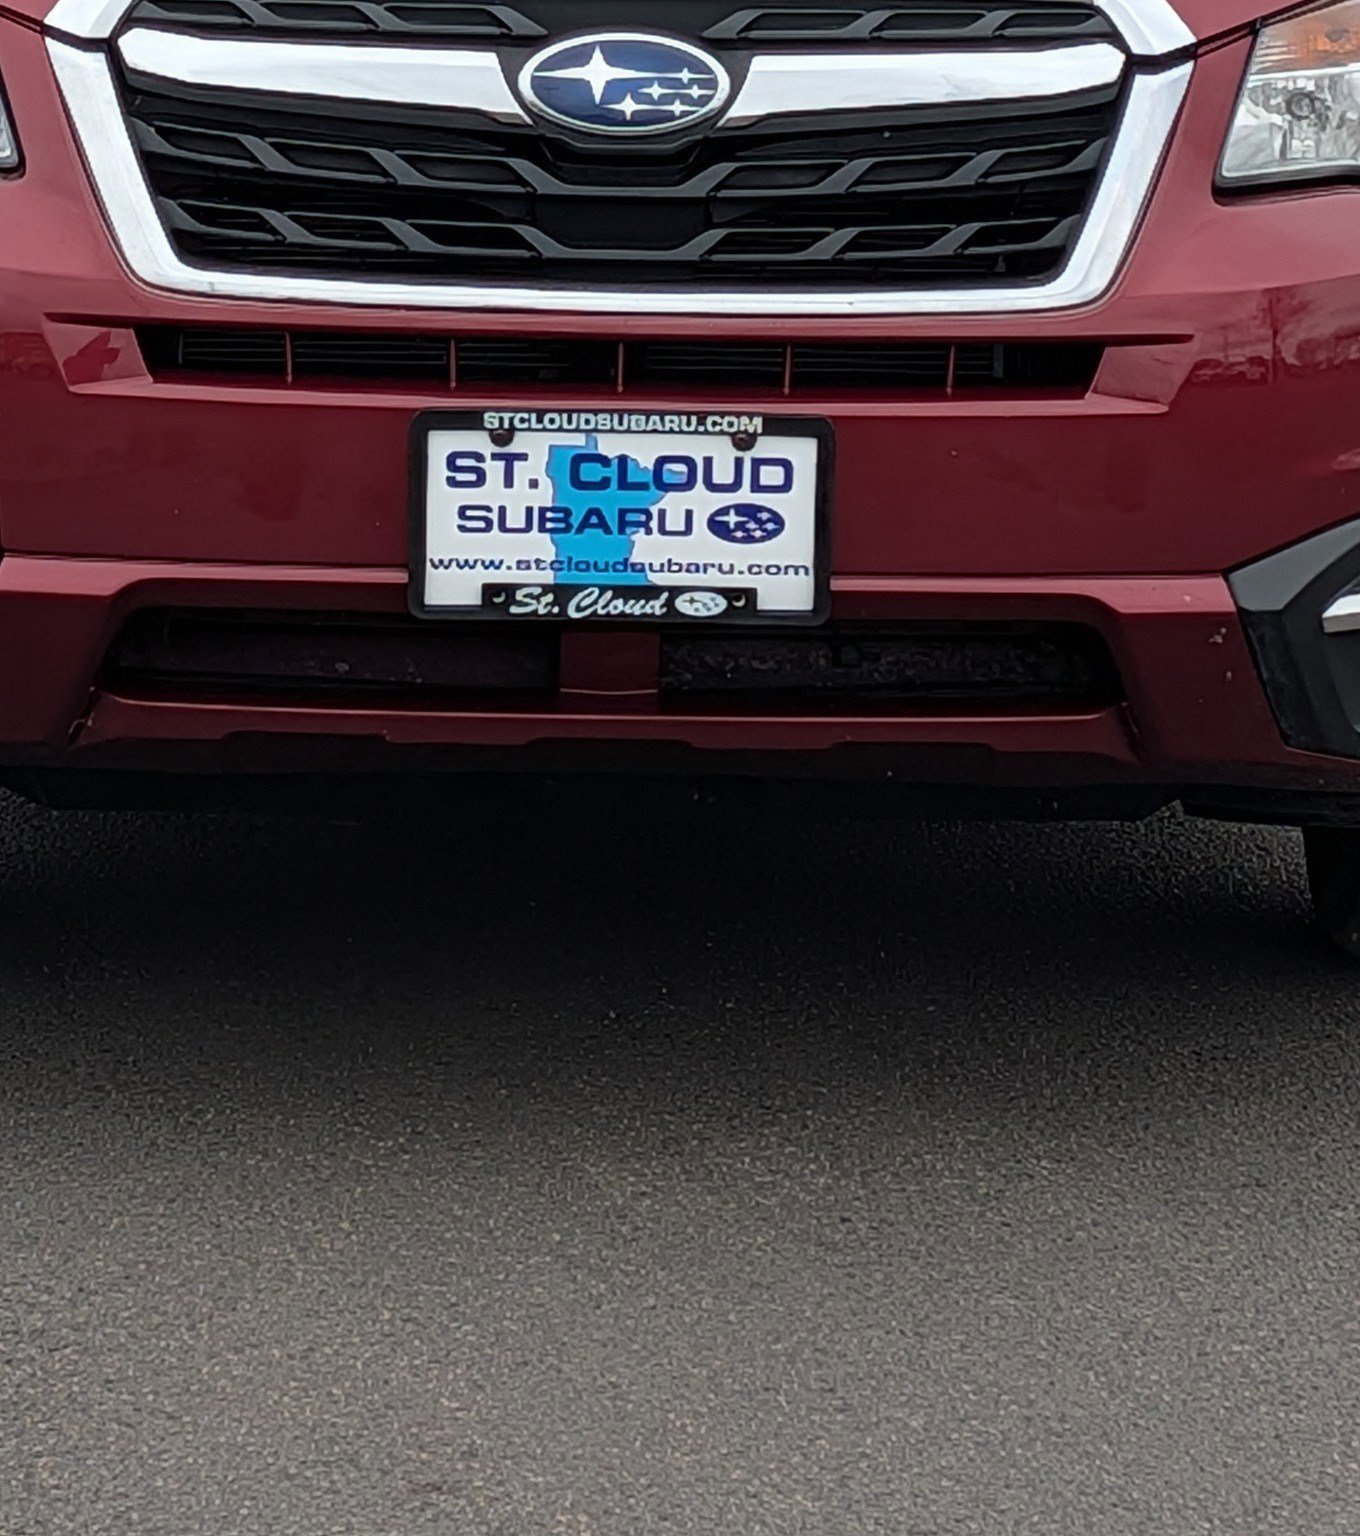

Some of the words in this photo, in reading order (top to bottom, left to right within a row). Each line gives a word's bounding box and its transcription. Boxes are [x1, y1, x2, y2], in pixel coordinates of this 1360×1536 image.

[483, 411, 763, 434] STCLOUDSUBARU.COM
[445, 450, 540, 490] ST.
[568, 452, 795, 495] CLOUD
[456, 504, 694, 537] SUBARU
[429, 555, 810, 577] www.stcloudsubaru.com
[509, 586, 560, 616] St.
[567, 587, 669, 619] Cloud
